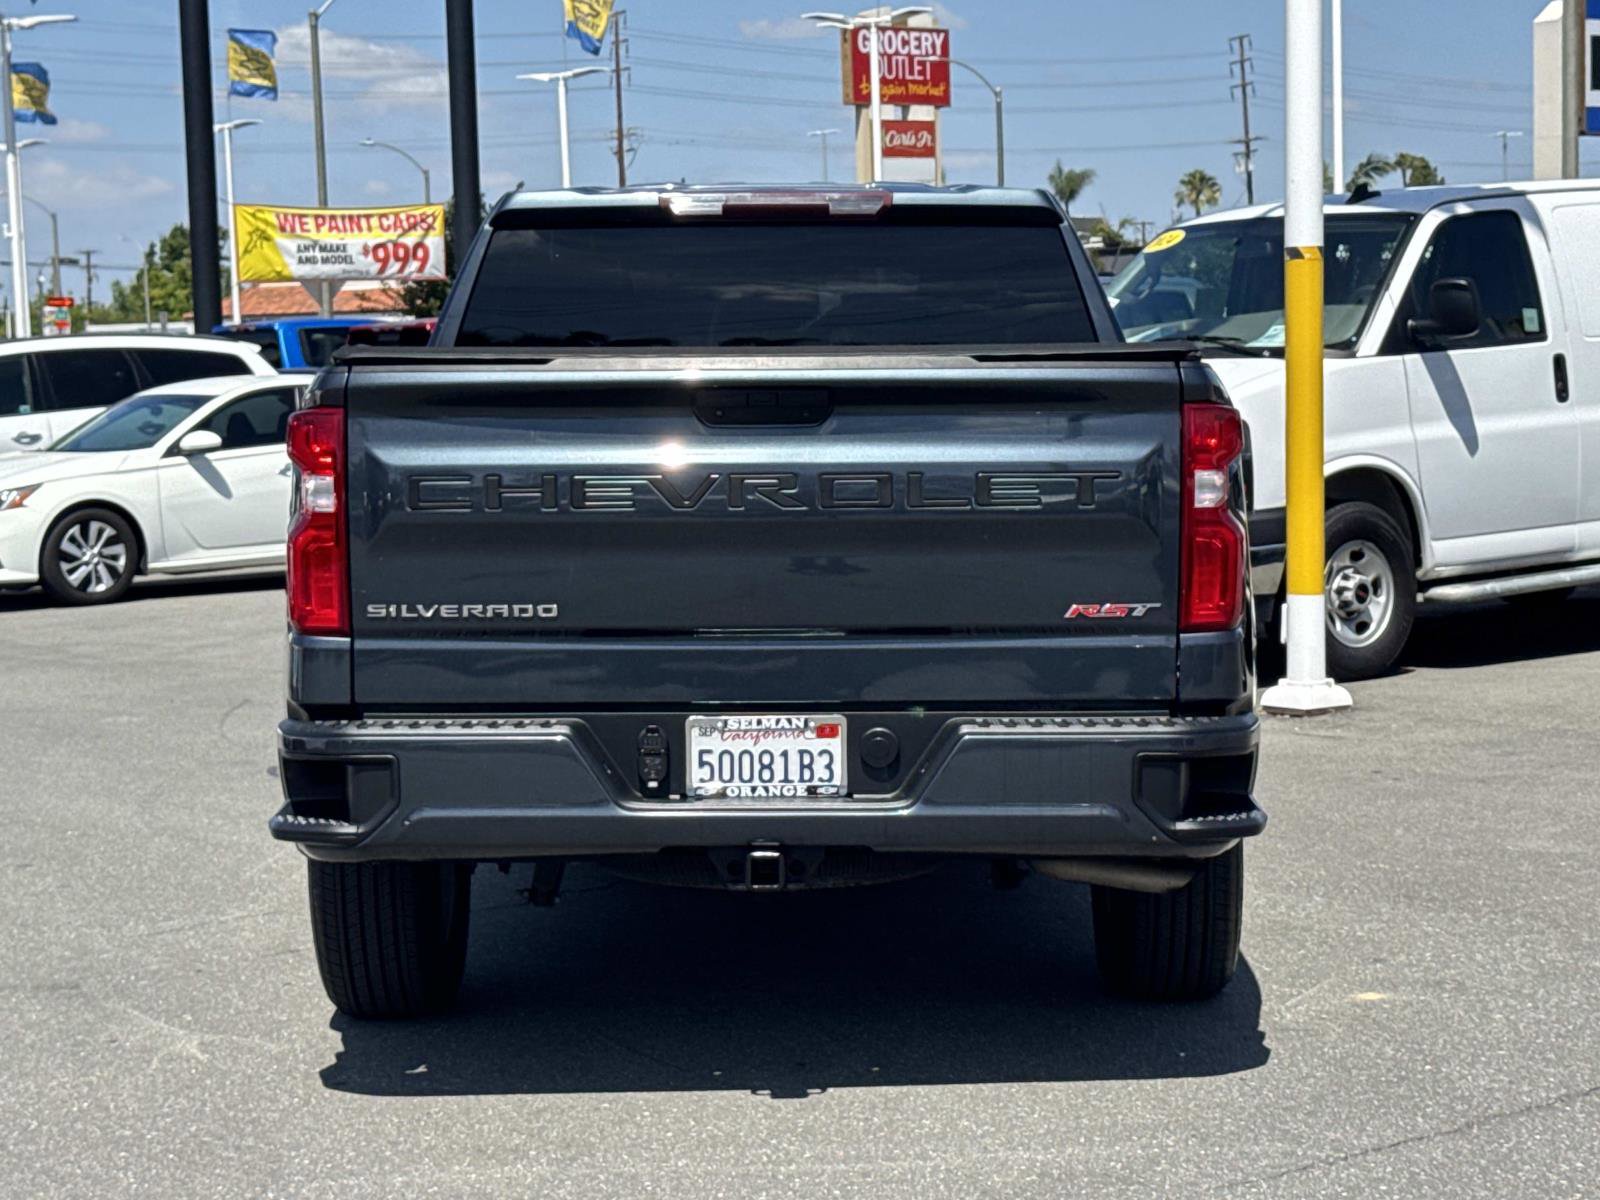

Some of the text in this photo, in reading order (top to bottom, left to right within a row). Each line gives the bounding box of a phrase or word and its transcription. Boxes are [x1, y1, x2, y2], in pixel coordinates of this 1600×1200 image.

[859, 74, 906, 102] bgain
[276, 213, 311, 234] WE
[315, 212, 373, 233] PAINT
[297, 243, 347, 253] ANY MAKE
[297, 254, 355, 265] AND MODEL
[406, 472, 1122, 513] CHEVROLET
[366, 603, 559, 618] SILVERADO
[1063, 602, 1162, 619] RST
[726, 717, 806, 730] SELMAN
[699, 727, 715, 737] SEP
[720, 729, 806, 746] California
[697, 749, 835, 784] 50081B3
[726, 785, 808, 797] ORANGE
